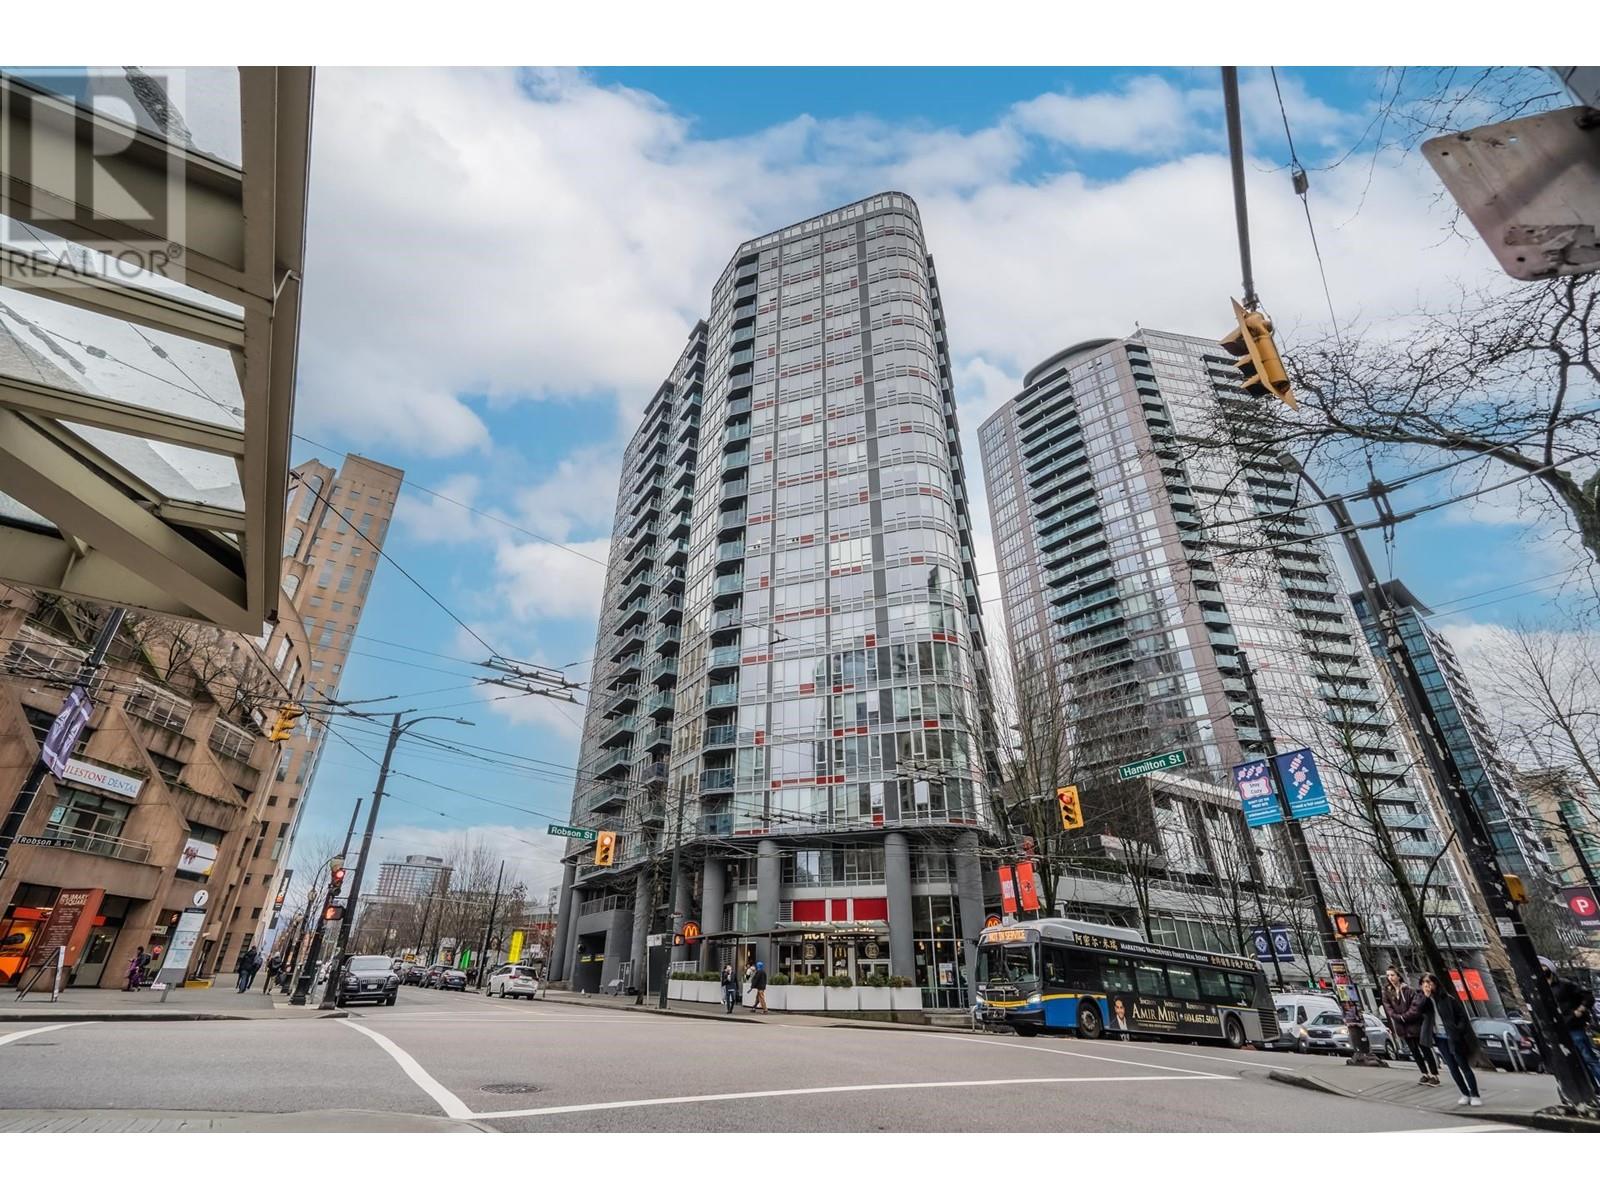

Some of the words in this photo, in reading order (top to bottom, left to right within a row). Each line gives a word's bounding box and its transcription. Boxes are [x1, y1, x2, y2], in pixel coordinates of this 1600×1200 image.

[1123, 759, 1166, 777] Hamilton
[1168, 753, 1182, 765] St
[107, 777, 138, 794] DENTAL
[551, 826, 582, 838] Robson
[583, 831, 593, 840] St
[20, 836, 52, 846] Robson
[1575, 899, 1589, 913] P
[1120, 943, 1146, 953] MARKETING
[1132, 1002, 1157, 1021] AMIR
[1158, 1005, 1180, 1022] MIRI
